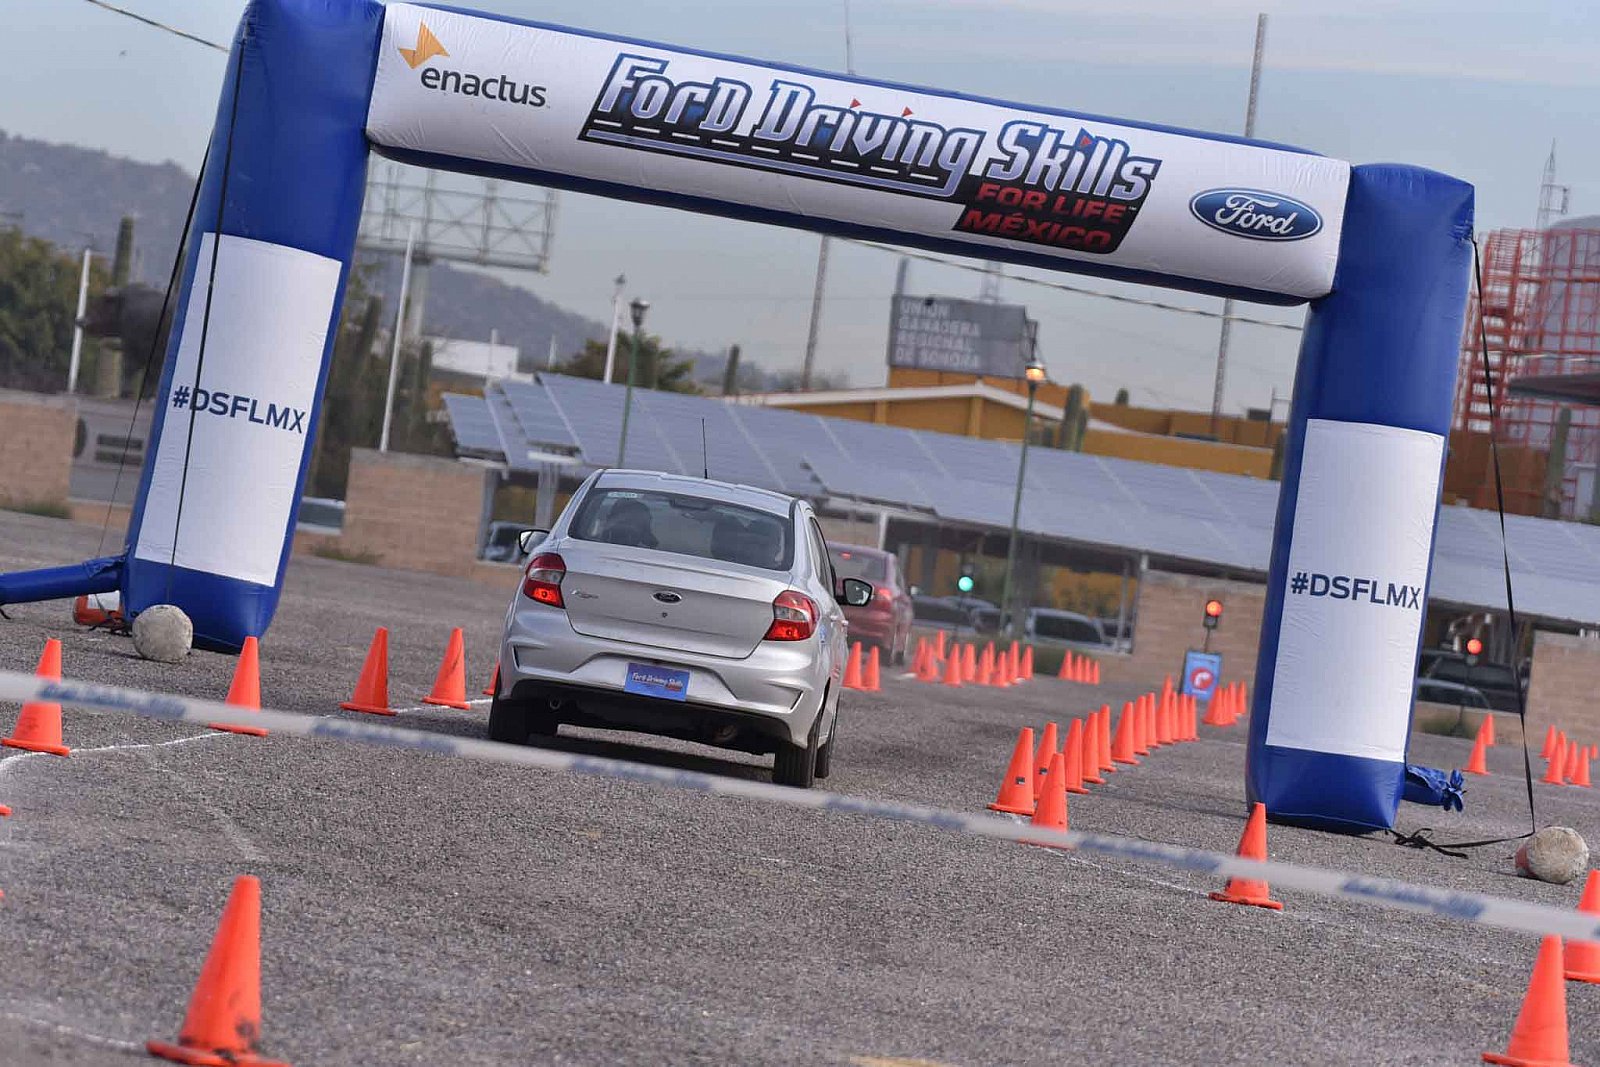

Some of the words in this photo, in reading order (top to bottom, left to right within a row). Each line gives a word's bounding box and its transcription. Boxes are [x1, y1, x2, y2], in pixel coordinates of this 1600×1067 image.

[420, 66, 547, 107] enactus
[753, 80, 986, 196] Driving
[985, 120, 1161, 200] Skills
[976, 182, 1048, 211] FOR
[1052, 194, 1127, 223] LIFE
[1214, 194, 1298, 234] Ford
[962, 209, 1111, 248] MÉXICO
[172, 385, 306, 434] #DSFLMX
[1290, 572, 1421, 610] #DSFLMX
